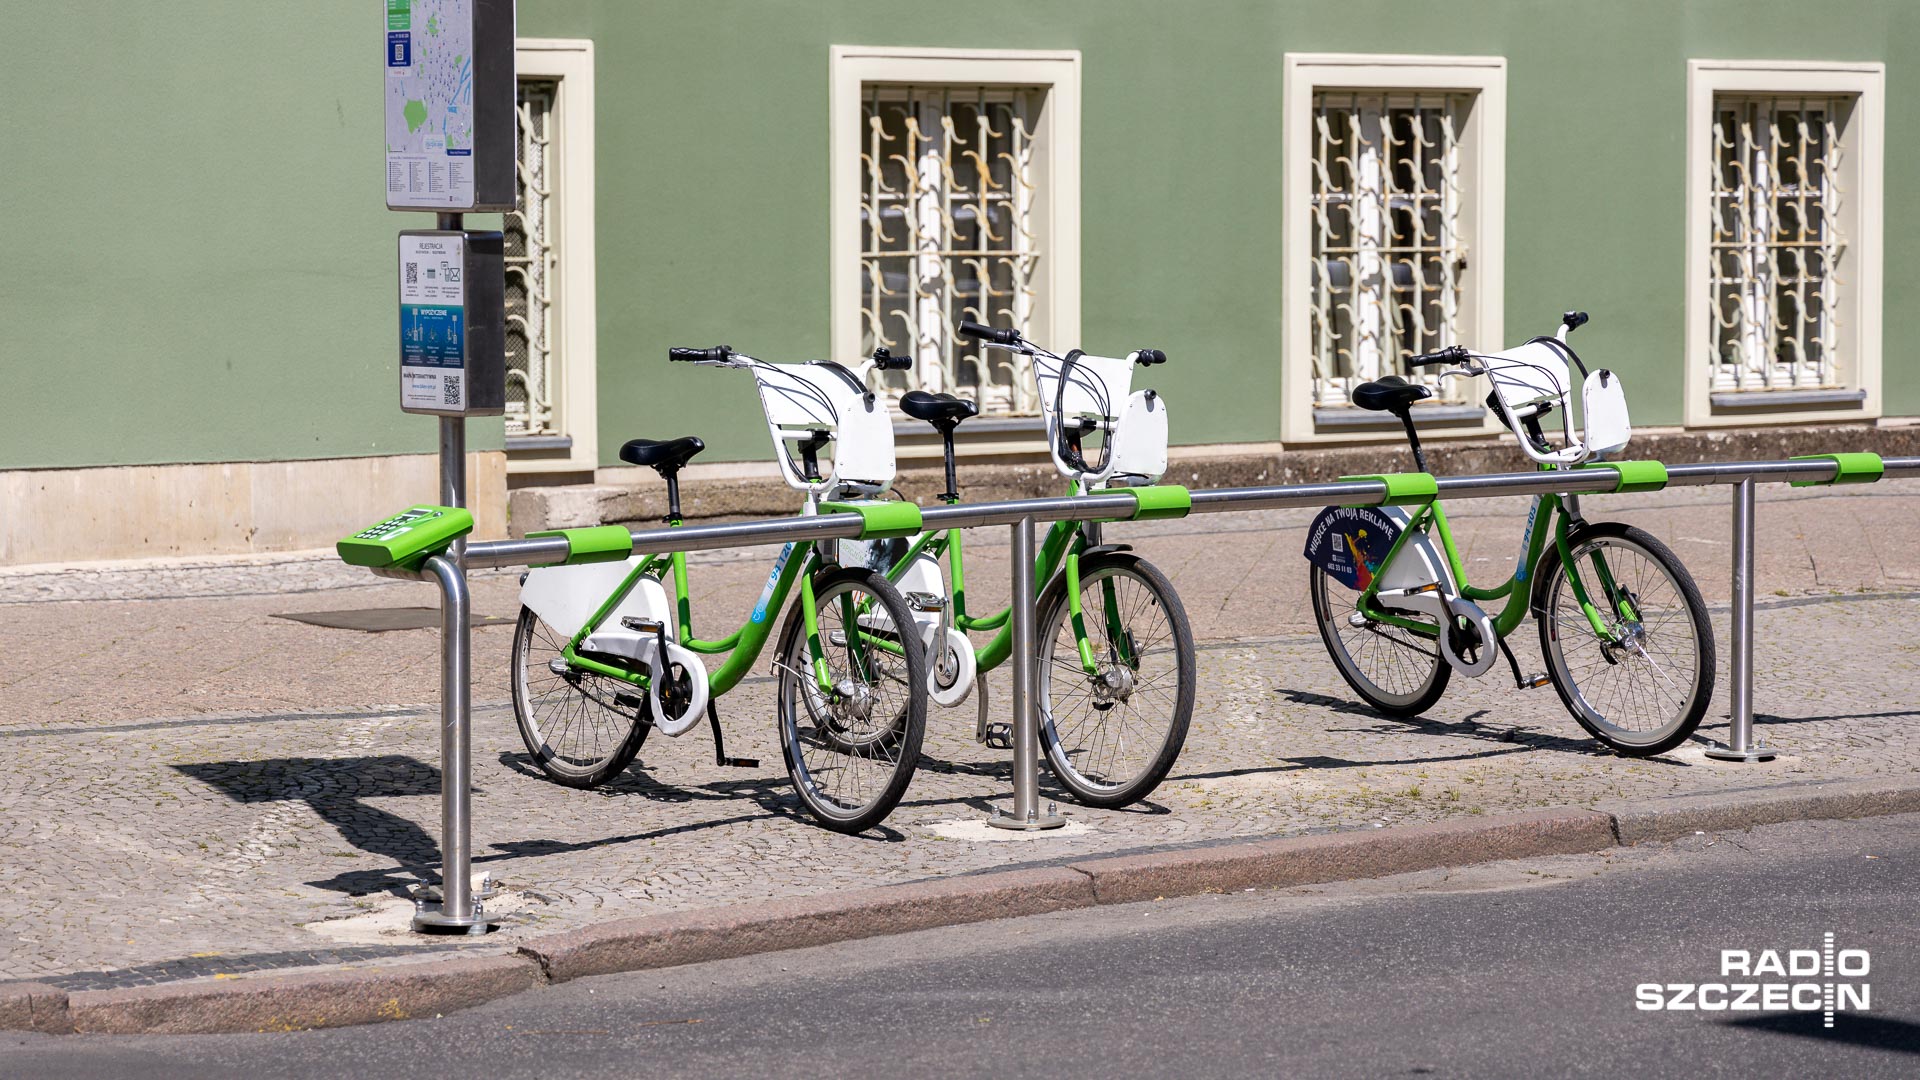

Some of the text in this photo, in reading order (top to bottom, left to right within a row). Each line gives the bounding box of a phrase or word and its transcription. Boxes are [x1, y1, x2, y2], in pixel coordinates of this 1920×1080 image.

[1309, 508, 1394, 555] MIEJSCE NA TWOJĄ REKLAMĘ
[770, 564, 781, 581] 94
